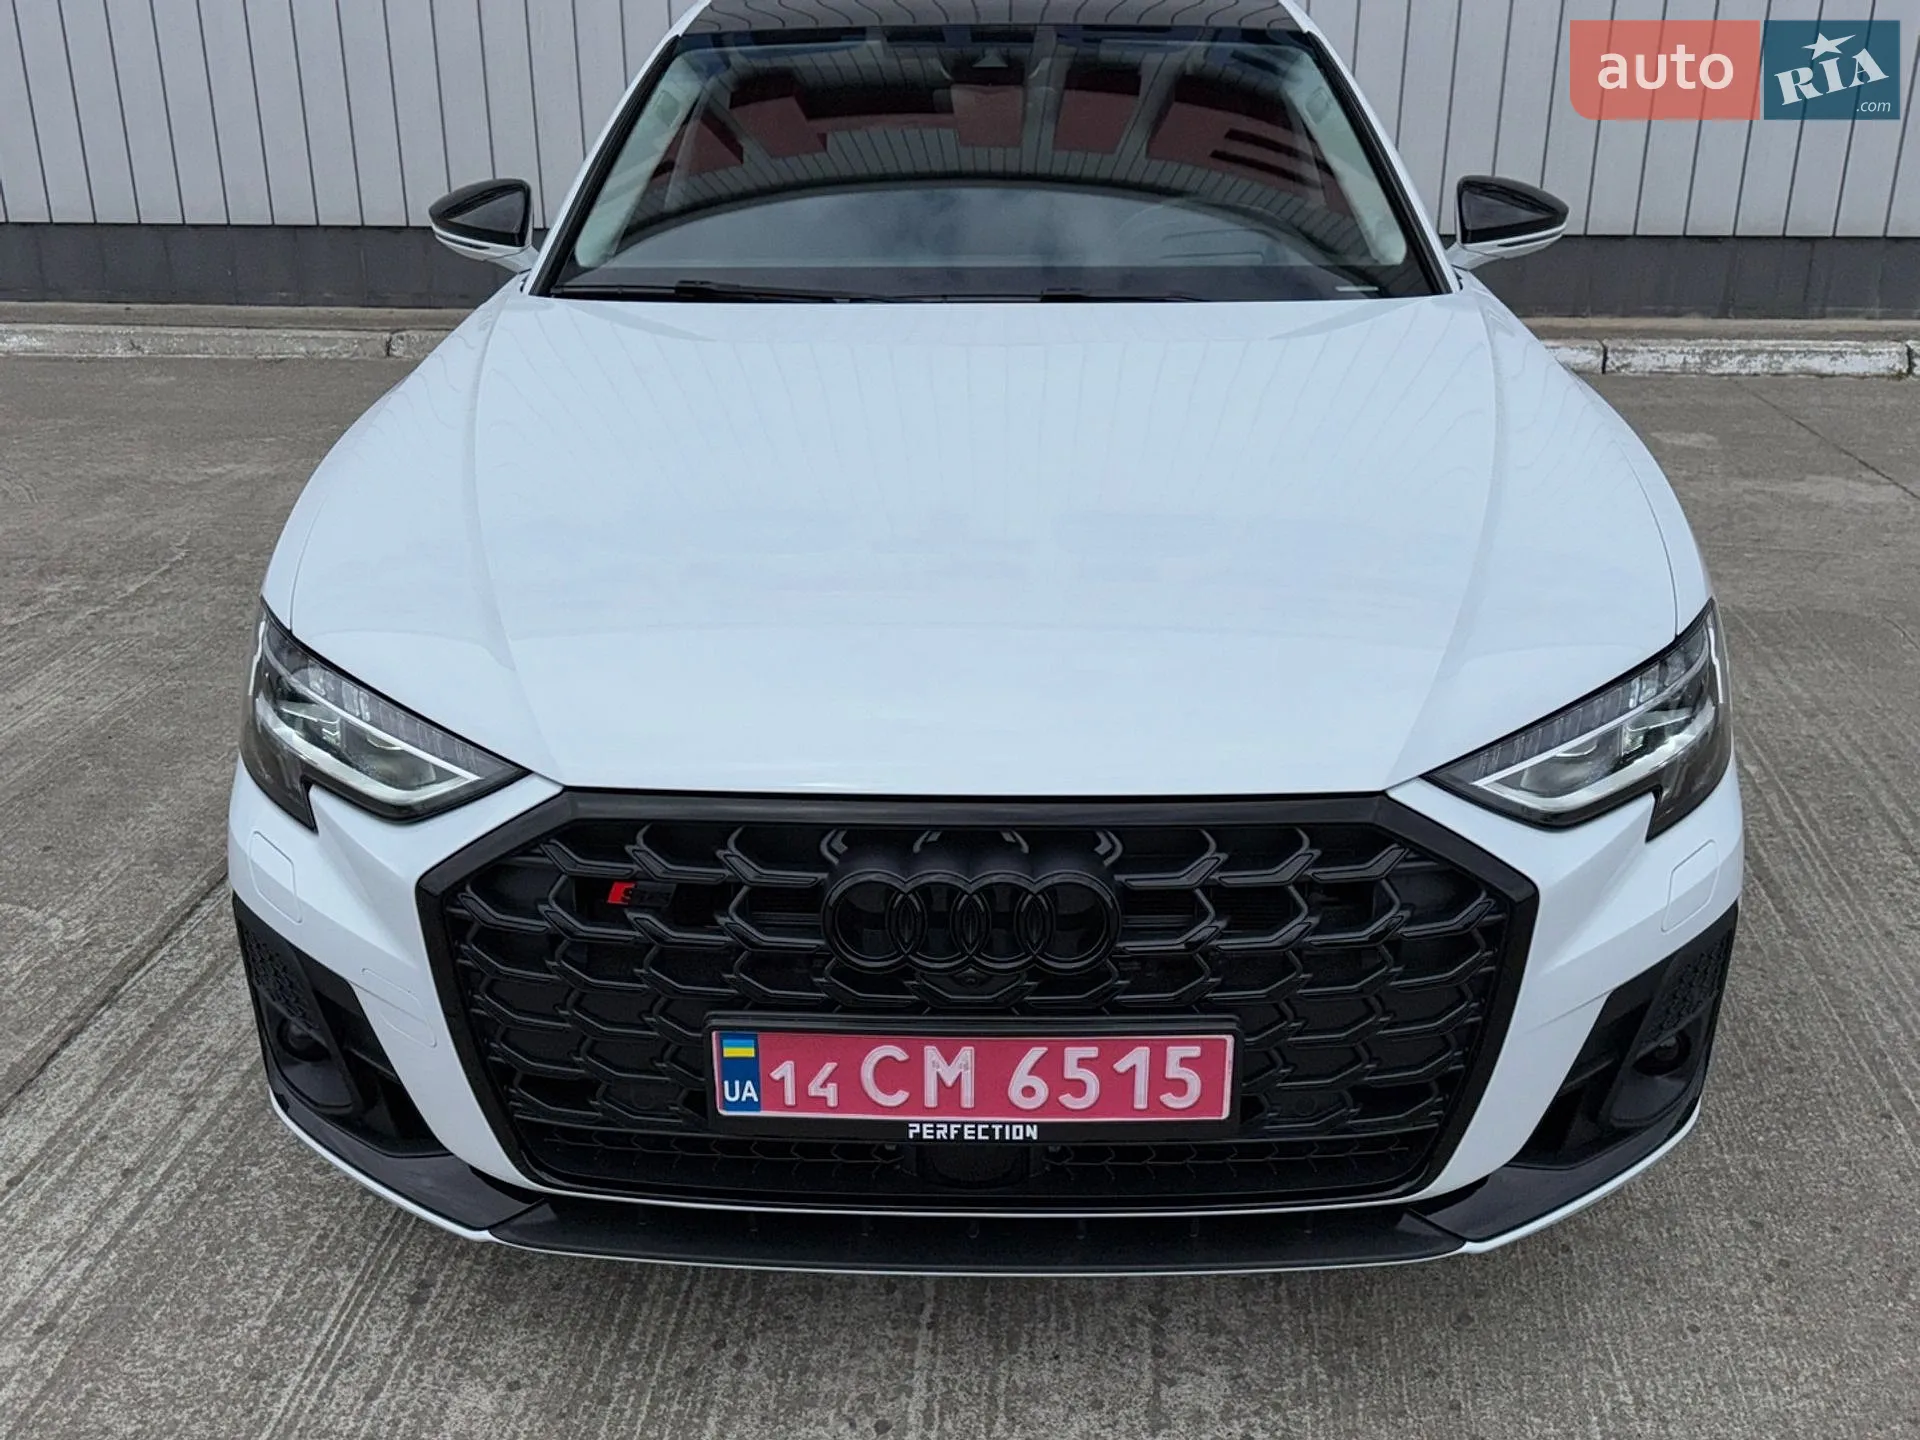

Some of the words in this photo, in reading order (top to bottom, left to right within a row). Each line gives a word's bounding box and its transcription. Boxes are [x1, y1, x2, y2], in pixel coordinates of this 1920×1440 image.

[770, 1061, 838, 1107] 14
[860, 1044, 975, 1109] CM
[1007, 1046, 1201, 1110] 6515
[724, 1079, 758, 1102] UA
[908, 1123, 1038, 1140] PERFECTION
